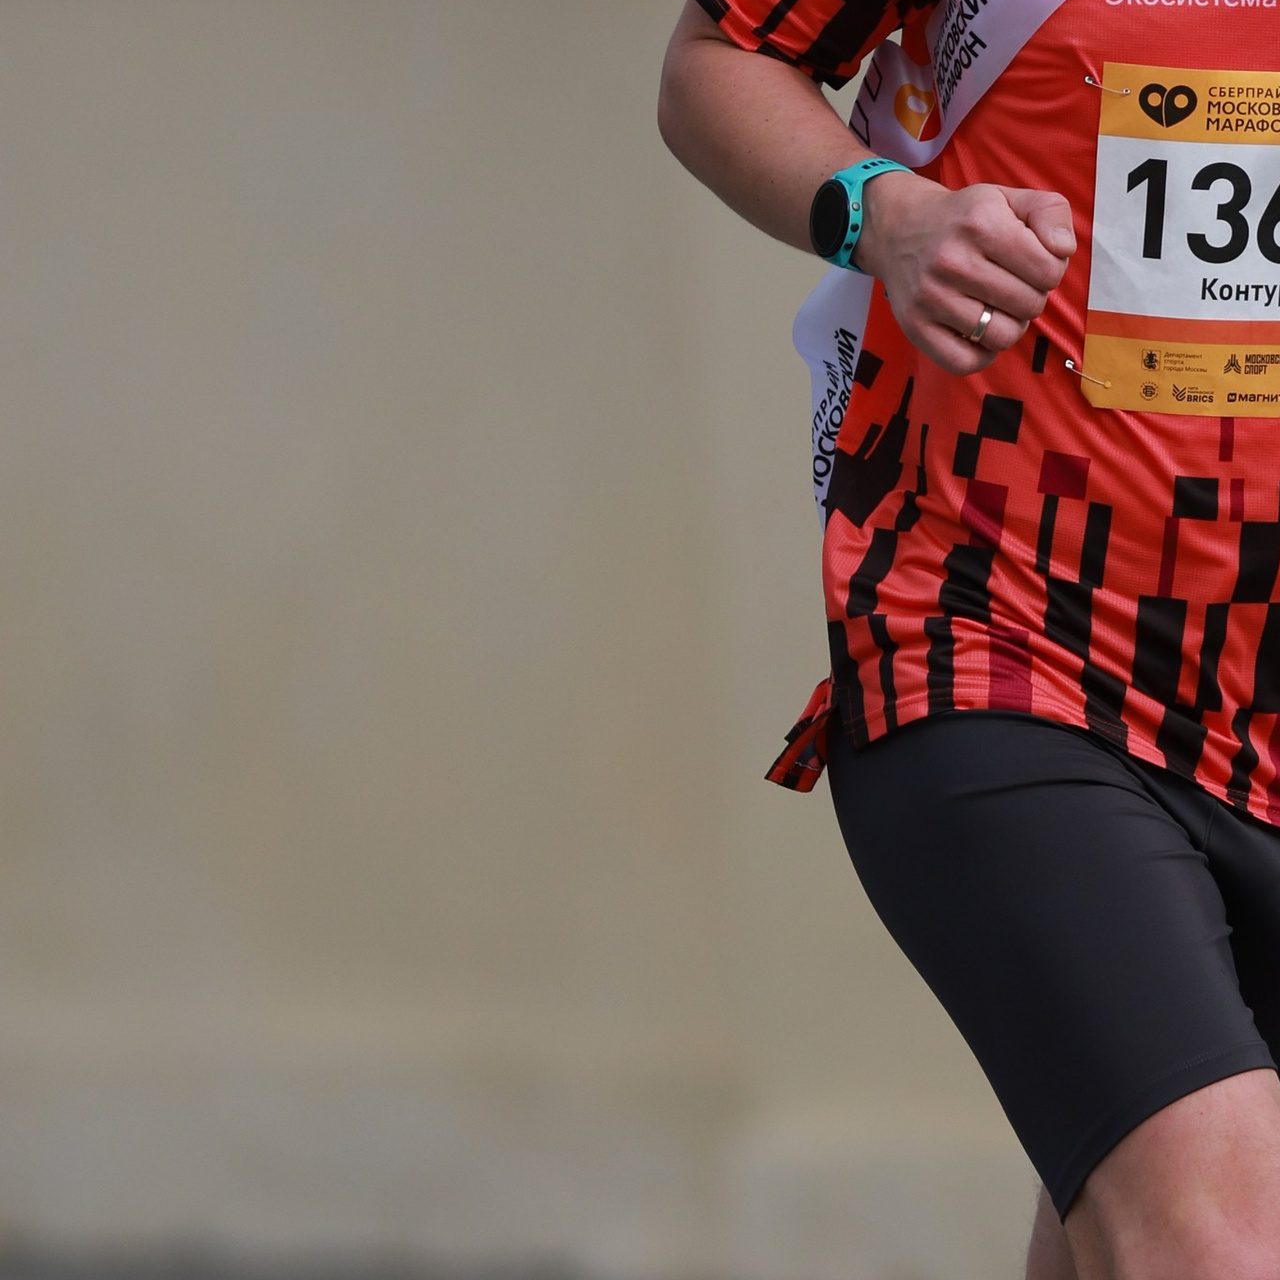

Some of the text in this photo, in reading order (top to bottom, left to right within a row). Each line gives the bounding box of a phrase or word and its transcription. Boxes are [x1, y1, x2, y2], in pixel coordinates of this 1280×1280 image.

[1244, 364, 1268, 375] СПОРТ
[1187, 394, 1214, 403] BRICS
[813, 327, 858, 488] ОСКОВСКИЙ
